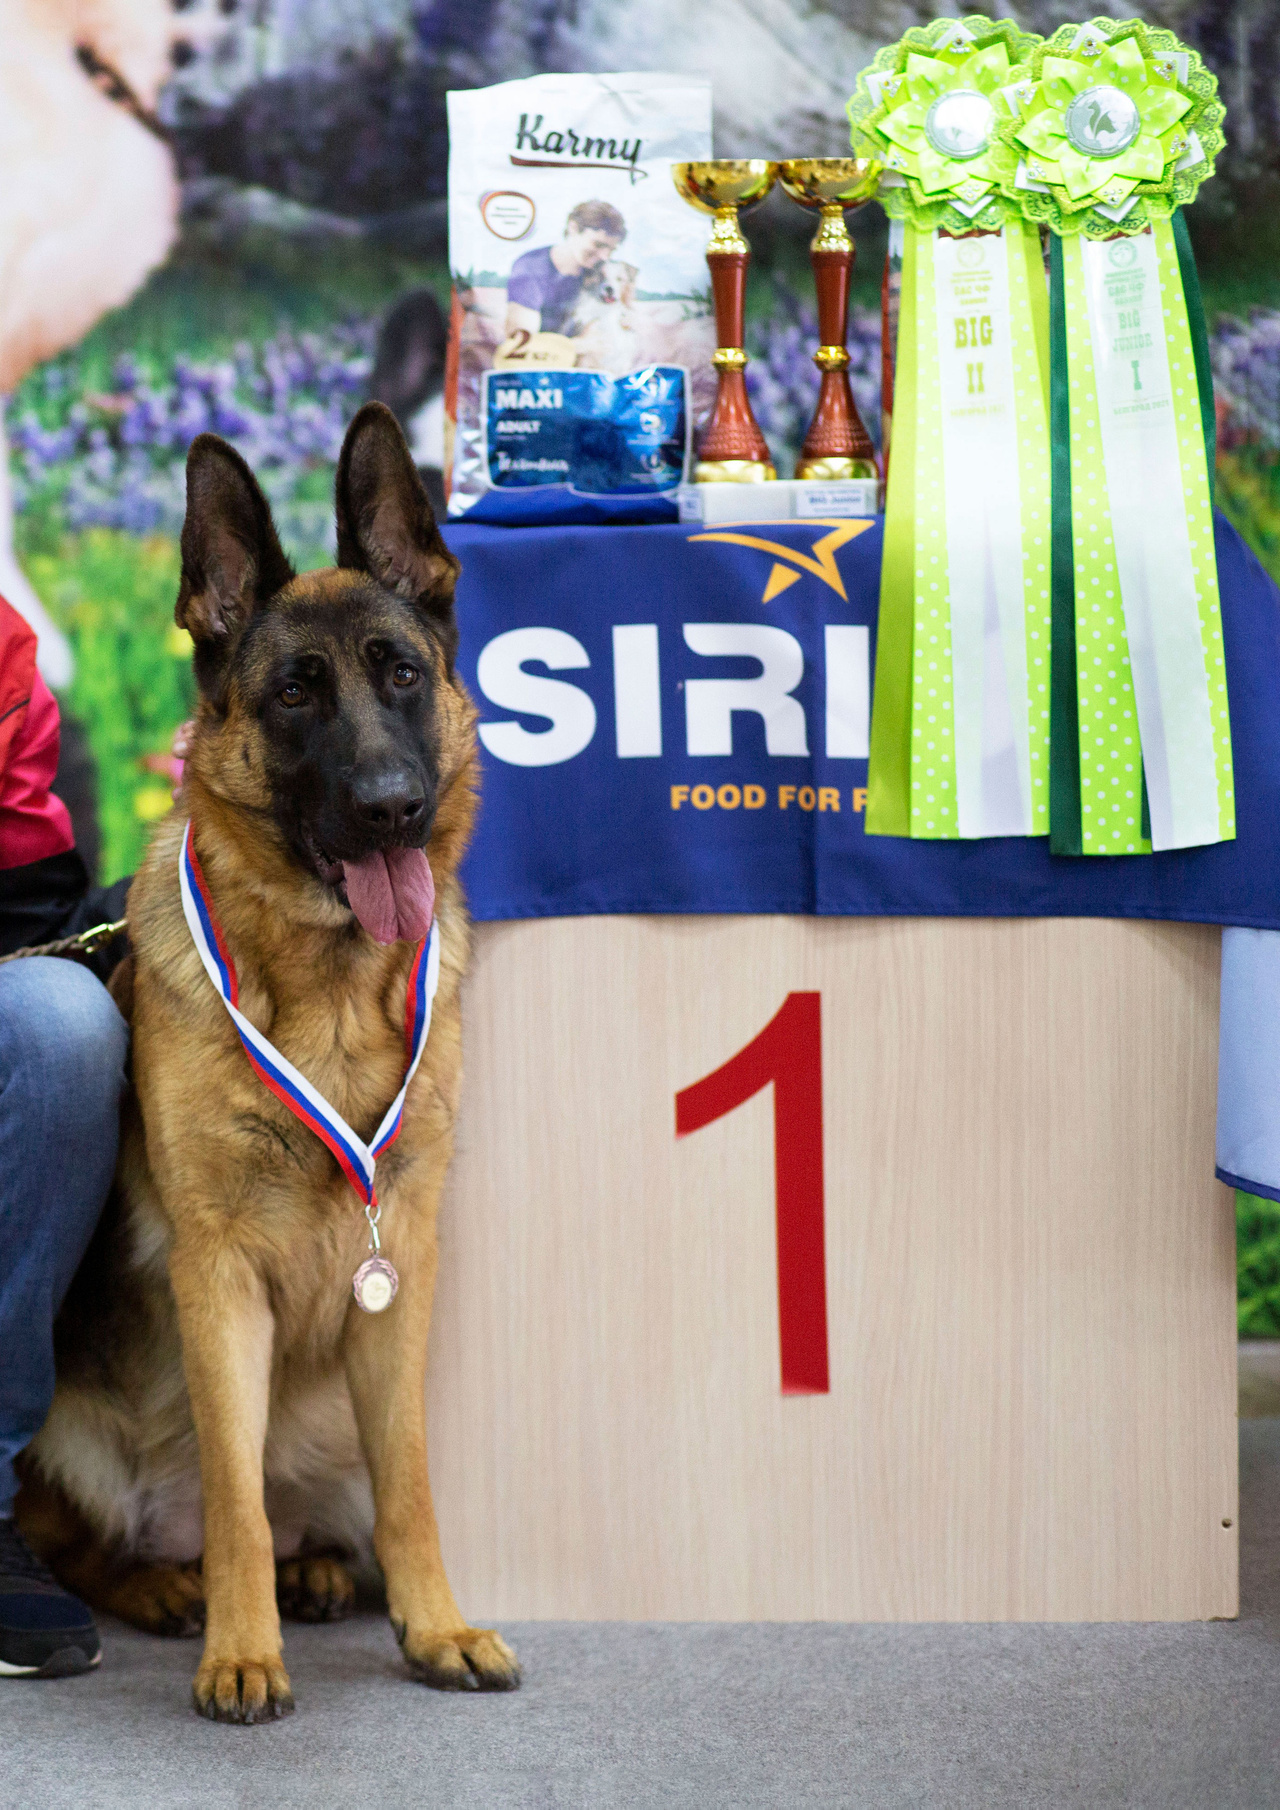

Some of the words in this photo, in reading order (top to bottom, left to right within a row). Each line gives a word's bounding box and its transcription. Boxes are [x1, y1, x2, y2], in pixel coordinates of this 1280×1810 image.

[515, 112, 643, 185] Karmy
[953, 315, 994, 349] BIG
[1117, 309, 1141, 329] BIG
[504, 328, 531, 360] 2
[1111, 332, 1154, 353] JUNIOR
[966, 362, 985, 394] II
[1131, 360, 1142, 391] I
[494, 388, 564, 410] MAXI
[495, 420, 542, 434] ADULT
[477, 622, 871, 767] SIRI
[670, 784, 767, 811] FOOD
[778, 786, 841, 812] FOR
[675, 990, 830, 1396] 1
